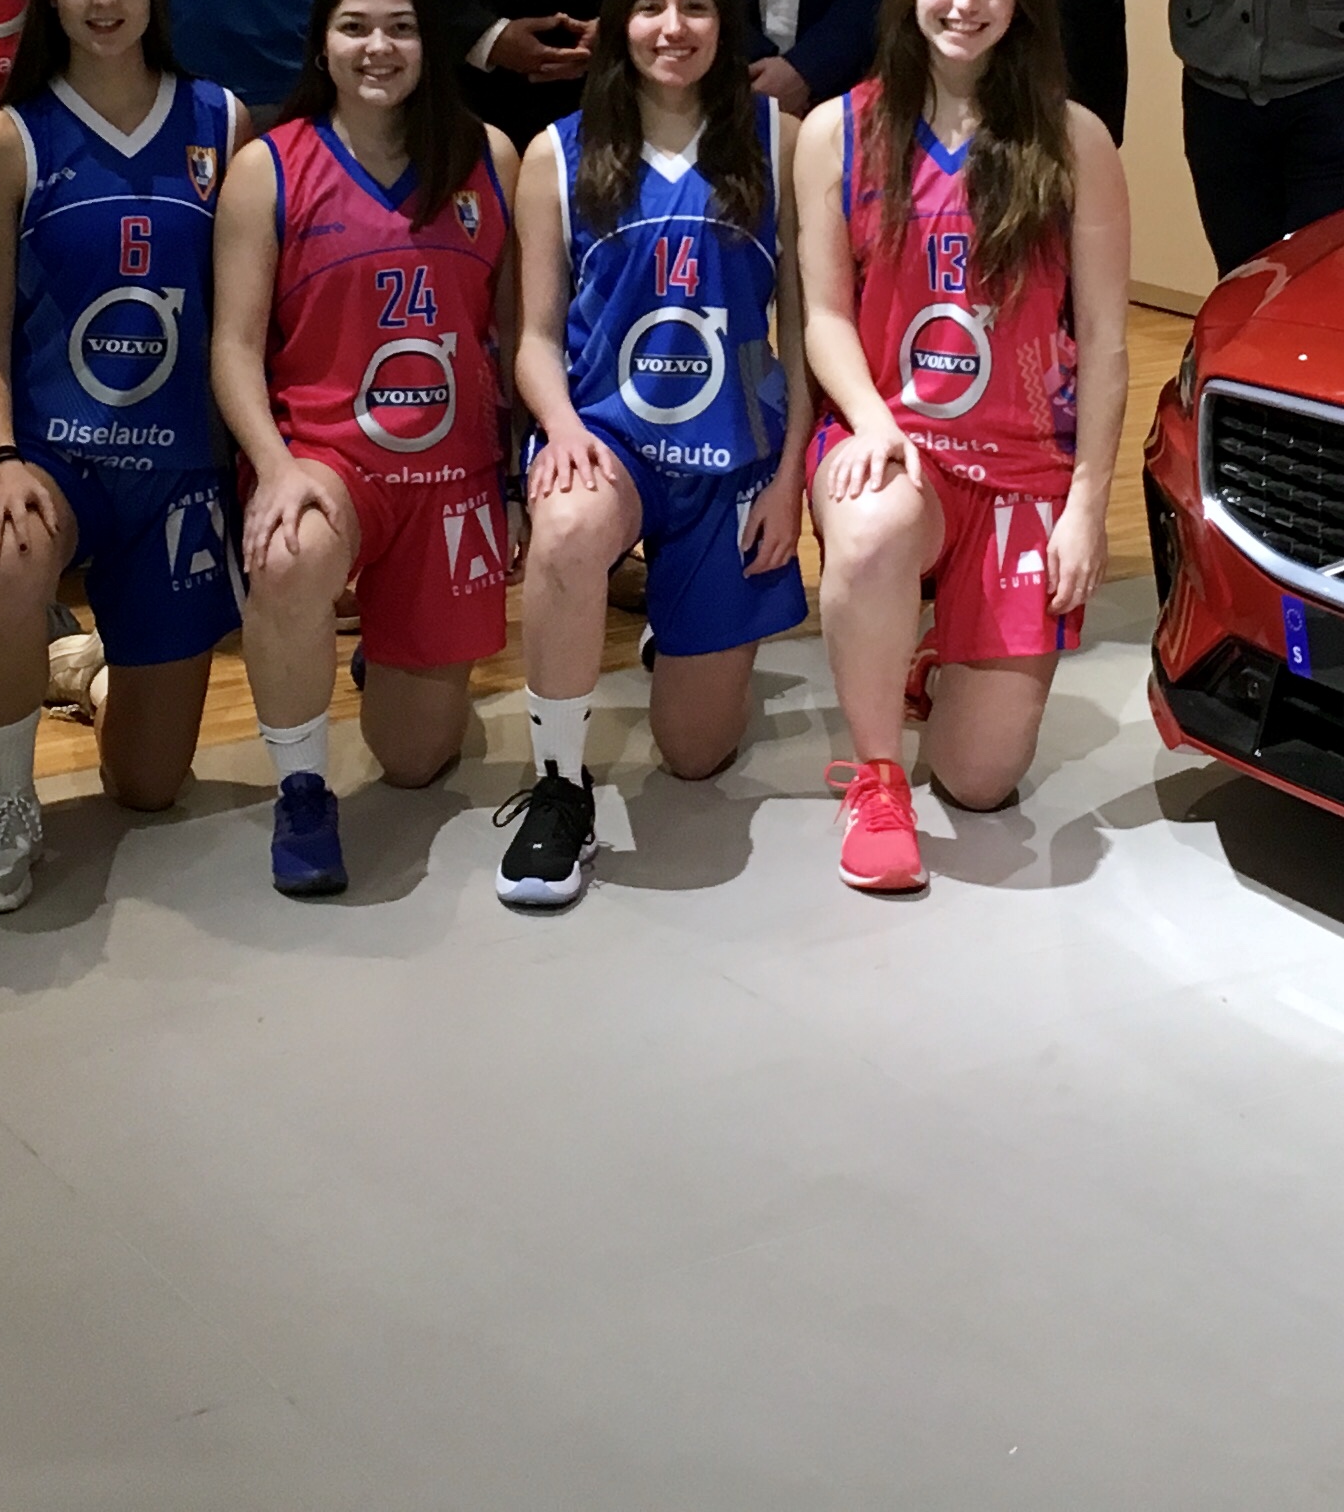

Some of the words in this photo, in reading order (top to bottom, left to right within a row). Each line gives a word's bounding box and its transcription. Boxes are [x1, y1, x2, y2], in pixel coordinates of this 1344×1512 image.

[119, 216, 152, 276] 6
[654, 236, 701, 297] 14
[927, 232, 969, 293] 13
[376, 265, 439, 328] 24
[87, 338, 163, 355] VOLVO
[634, 357, 708, 373] VOLVO
[914, 352, 976, 372] VOLVO
[372, 388, 447, 405] VOLVO
[47, 418, 175, 447] Diselauto
[636, 439, 731, 468] elauto
[442, 491, 489, 516] AMBIT
[1000, 574, 1041, 589] CUIN
[1292, 646, 1303, 663] S
